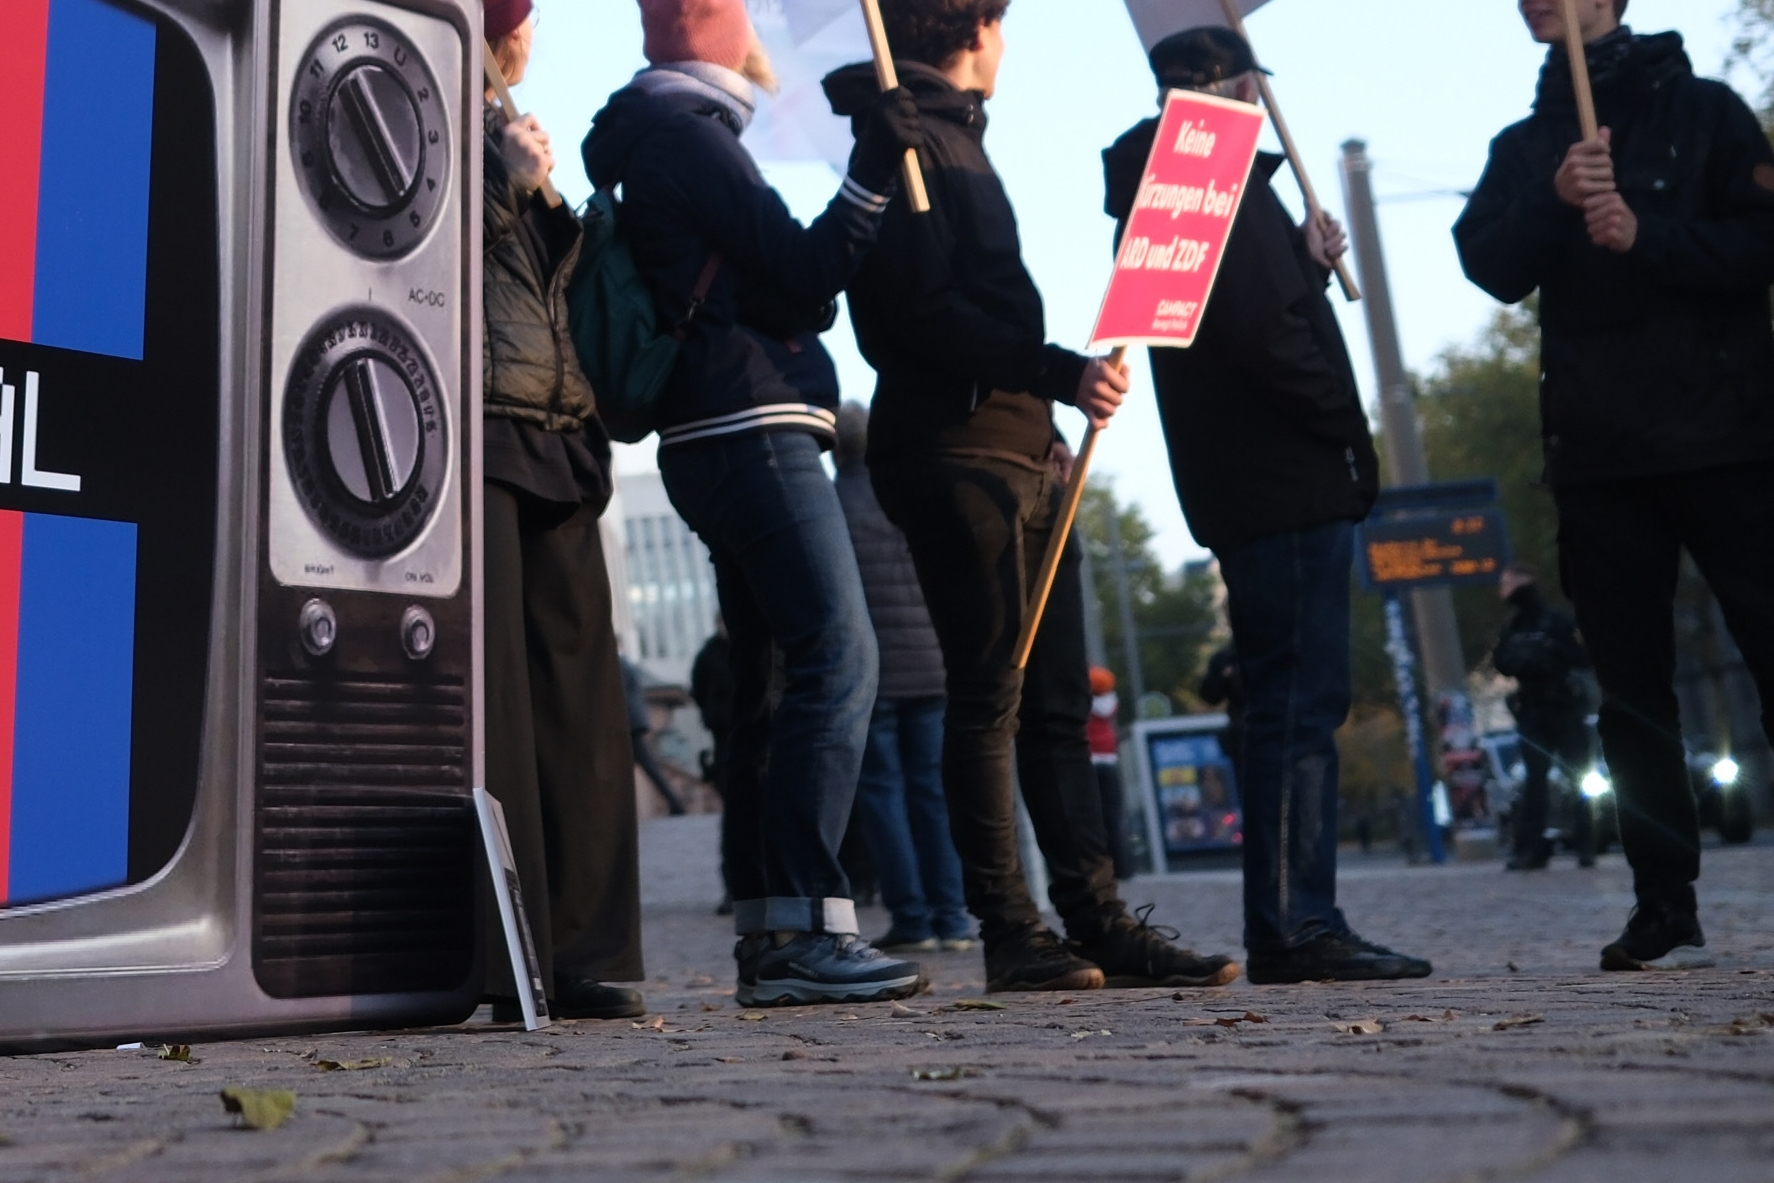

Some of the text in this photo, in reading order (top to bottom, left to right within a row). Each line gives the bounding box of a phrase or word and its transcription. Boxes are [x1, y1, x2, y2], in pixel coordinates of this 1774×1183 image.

[332, 33, 348, 53] 12
[363, 31, 379, 49] 13
[1173, 119, 1216, 158] Keine
[1203, 178, 1239, 217] bei
[1146, 234, 1179, 271] und
[1171, 237, 1210, 273] ZDF
